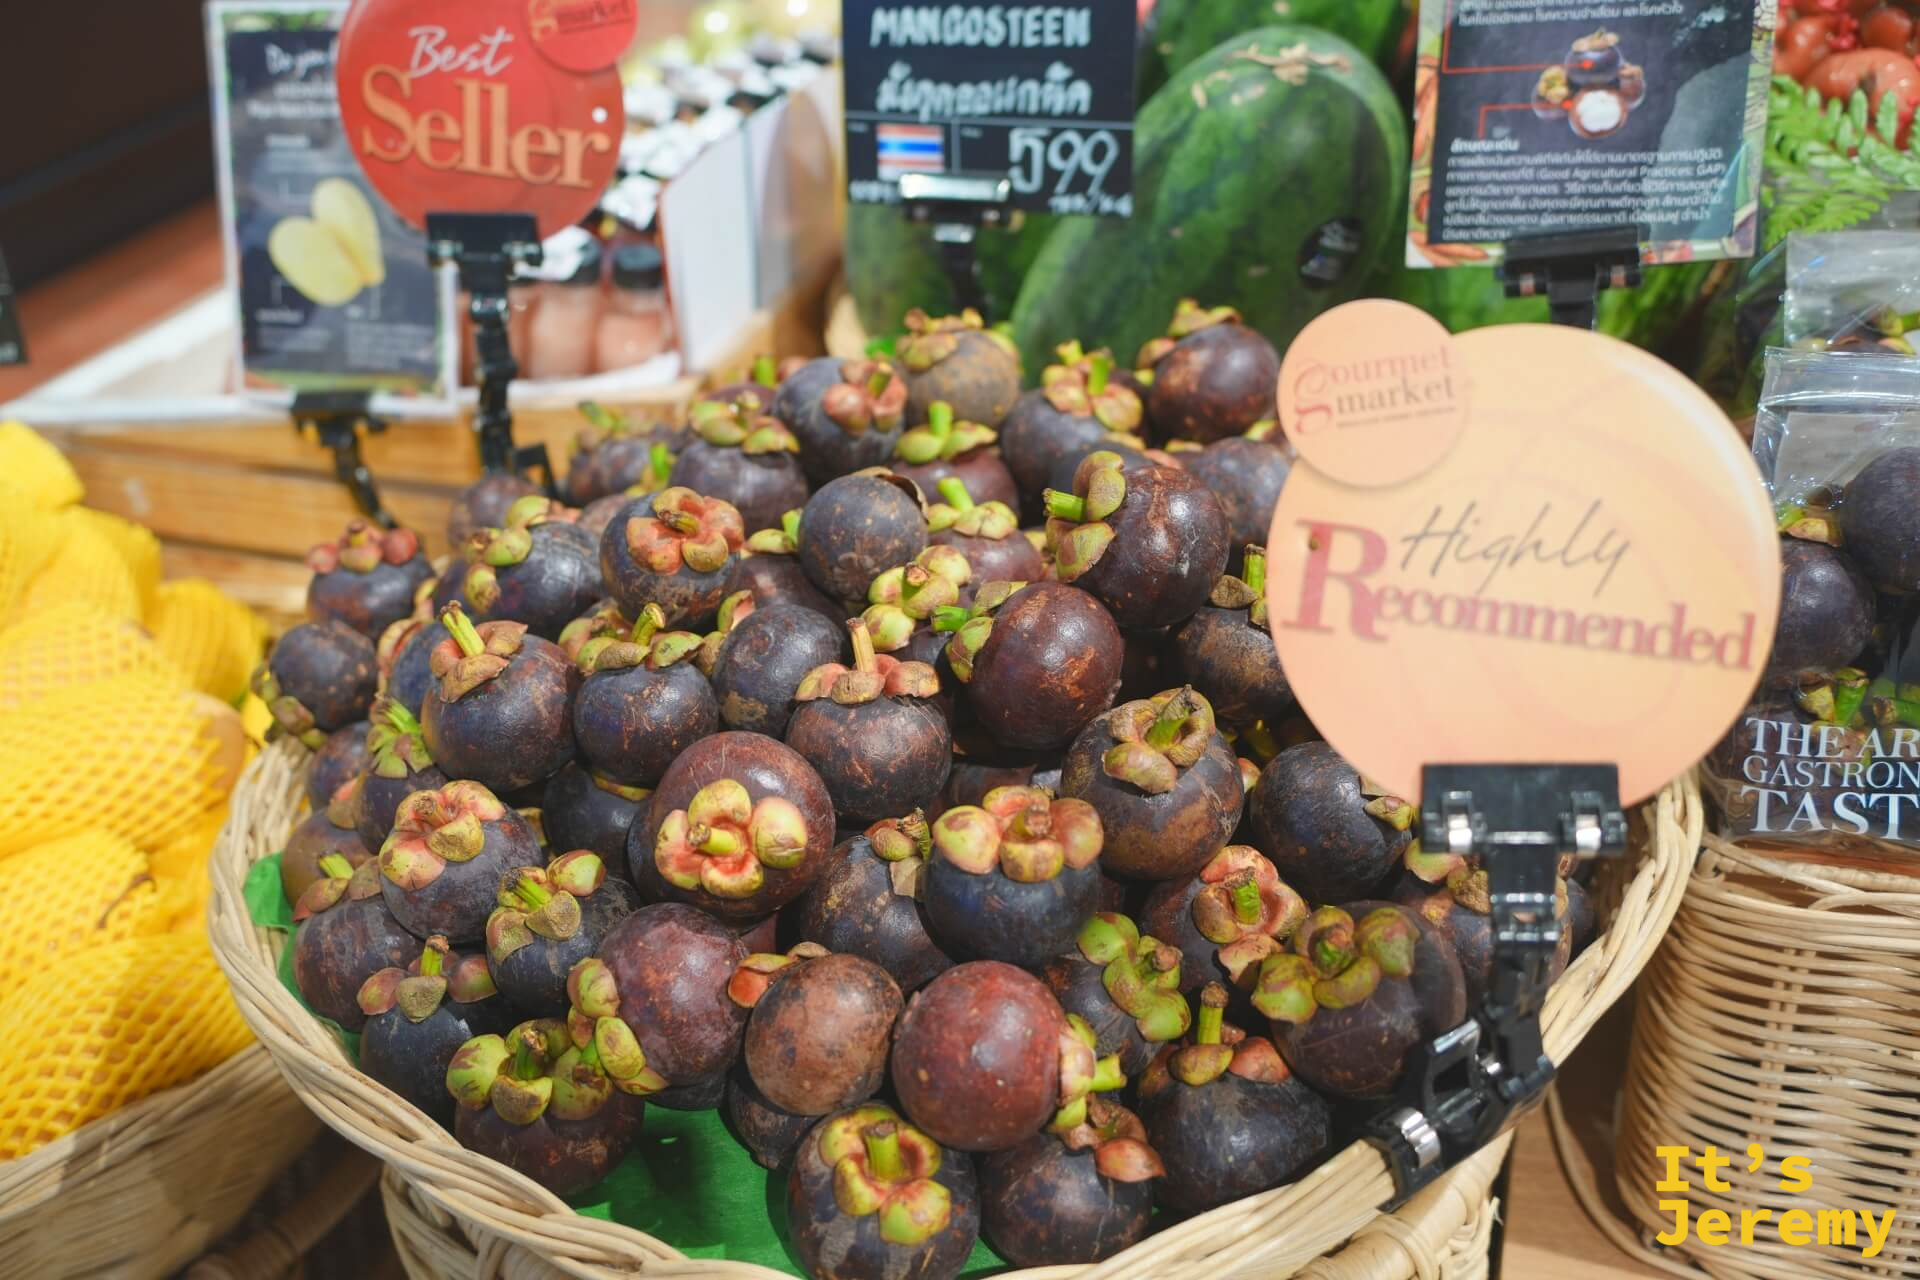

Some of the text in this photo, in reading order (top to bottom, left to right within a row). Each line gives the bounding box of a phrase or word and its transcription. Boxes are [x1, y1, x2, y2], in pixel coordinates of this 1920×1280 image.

[408, 25, 514, 78] Best
[869, 6, 1092, 47] MANGOSTEEN
[360, 64, 611, 189] Seller
[1008, 127, 1120, 197] 599
[1336, 374, 1455, 415] market
[1400, 499, 1630, 597] Highly
[1281, 518, 1757, 671] Recommended
[1745, 717, 1846, 758] THE
